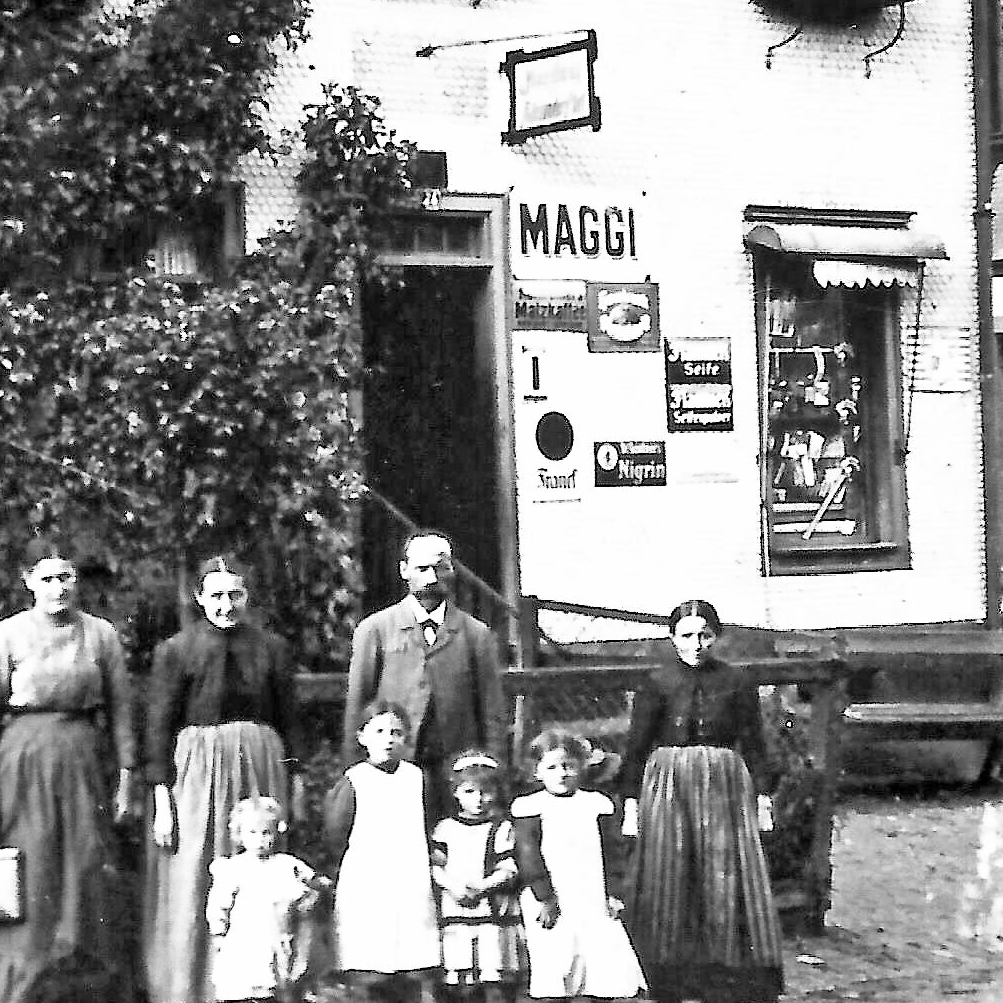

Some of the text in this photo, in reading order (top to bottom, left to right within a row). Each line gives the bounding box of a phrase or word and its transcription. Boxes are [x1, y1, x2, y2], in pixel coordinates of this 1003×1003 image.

[519, 203, 636, 257] MAGGI
[683, 361, 720, 376] Seife
[618, 459, 666, 485] Nigrin
